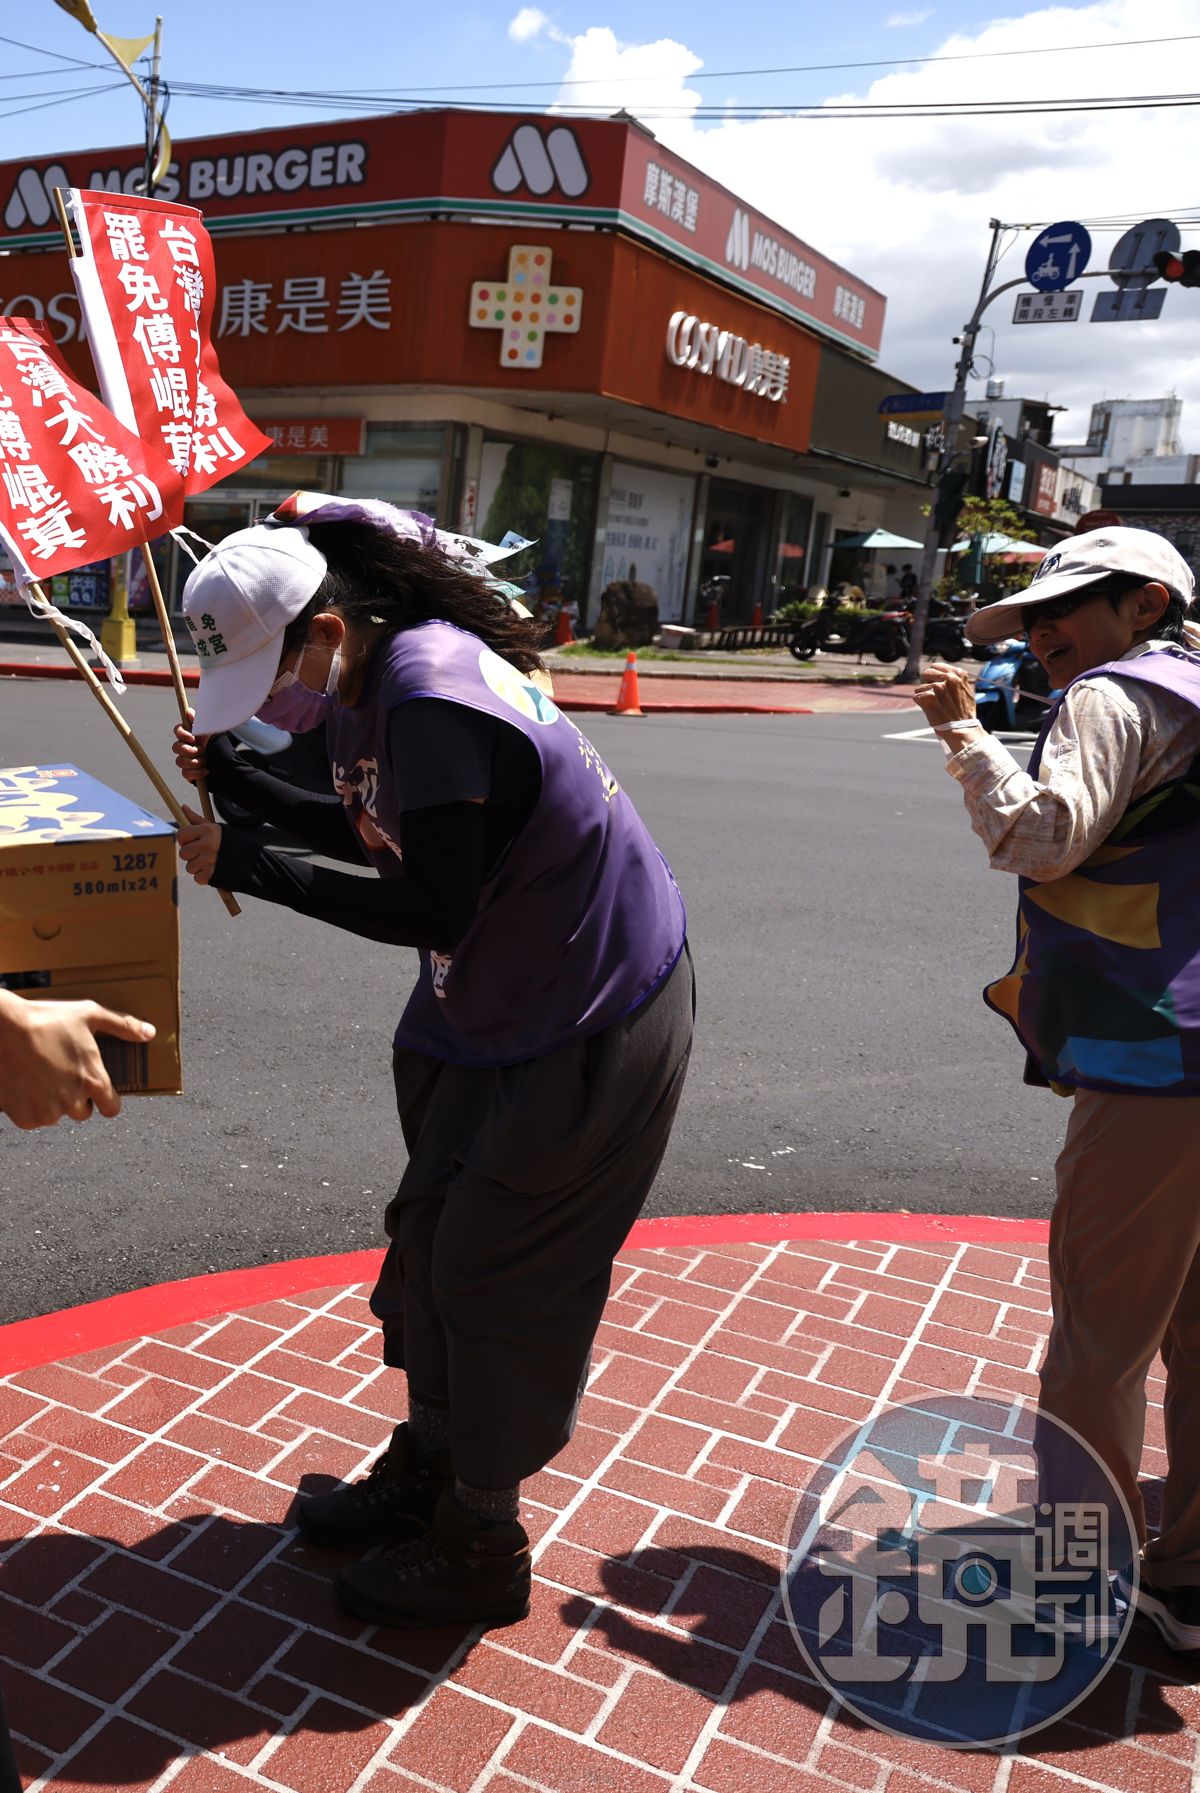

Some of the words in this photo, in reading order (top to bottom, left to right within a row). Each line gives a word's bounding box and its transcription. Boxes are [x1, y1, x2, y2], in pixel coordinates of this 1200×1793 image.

[188, 142, 367, 199] BURGER
[643, 160, 700, 233] 摩斯漢堡
[750, 231, 778, 275] MOS
[777, 247, 817, 300] BURGER
[217, 269, 393, 339] 康是美
[112, 852, 158, 872] 1287
